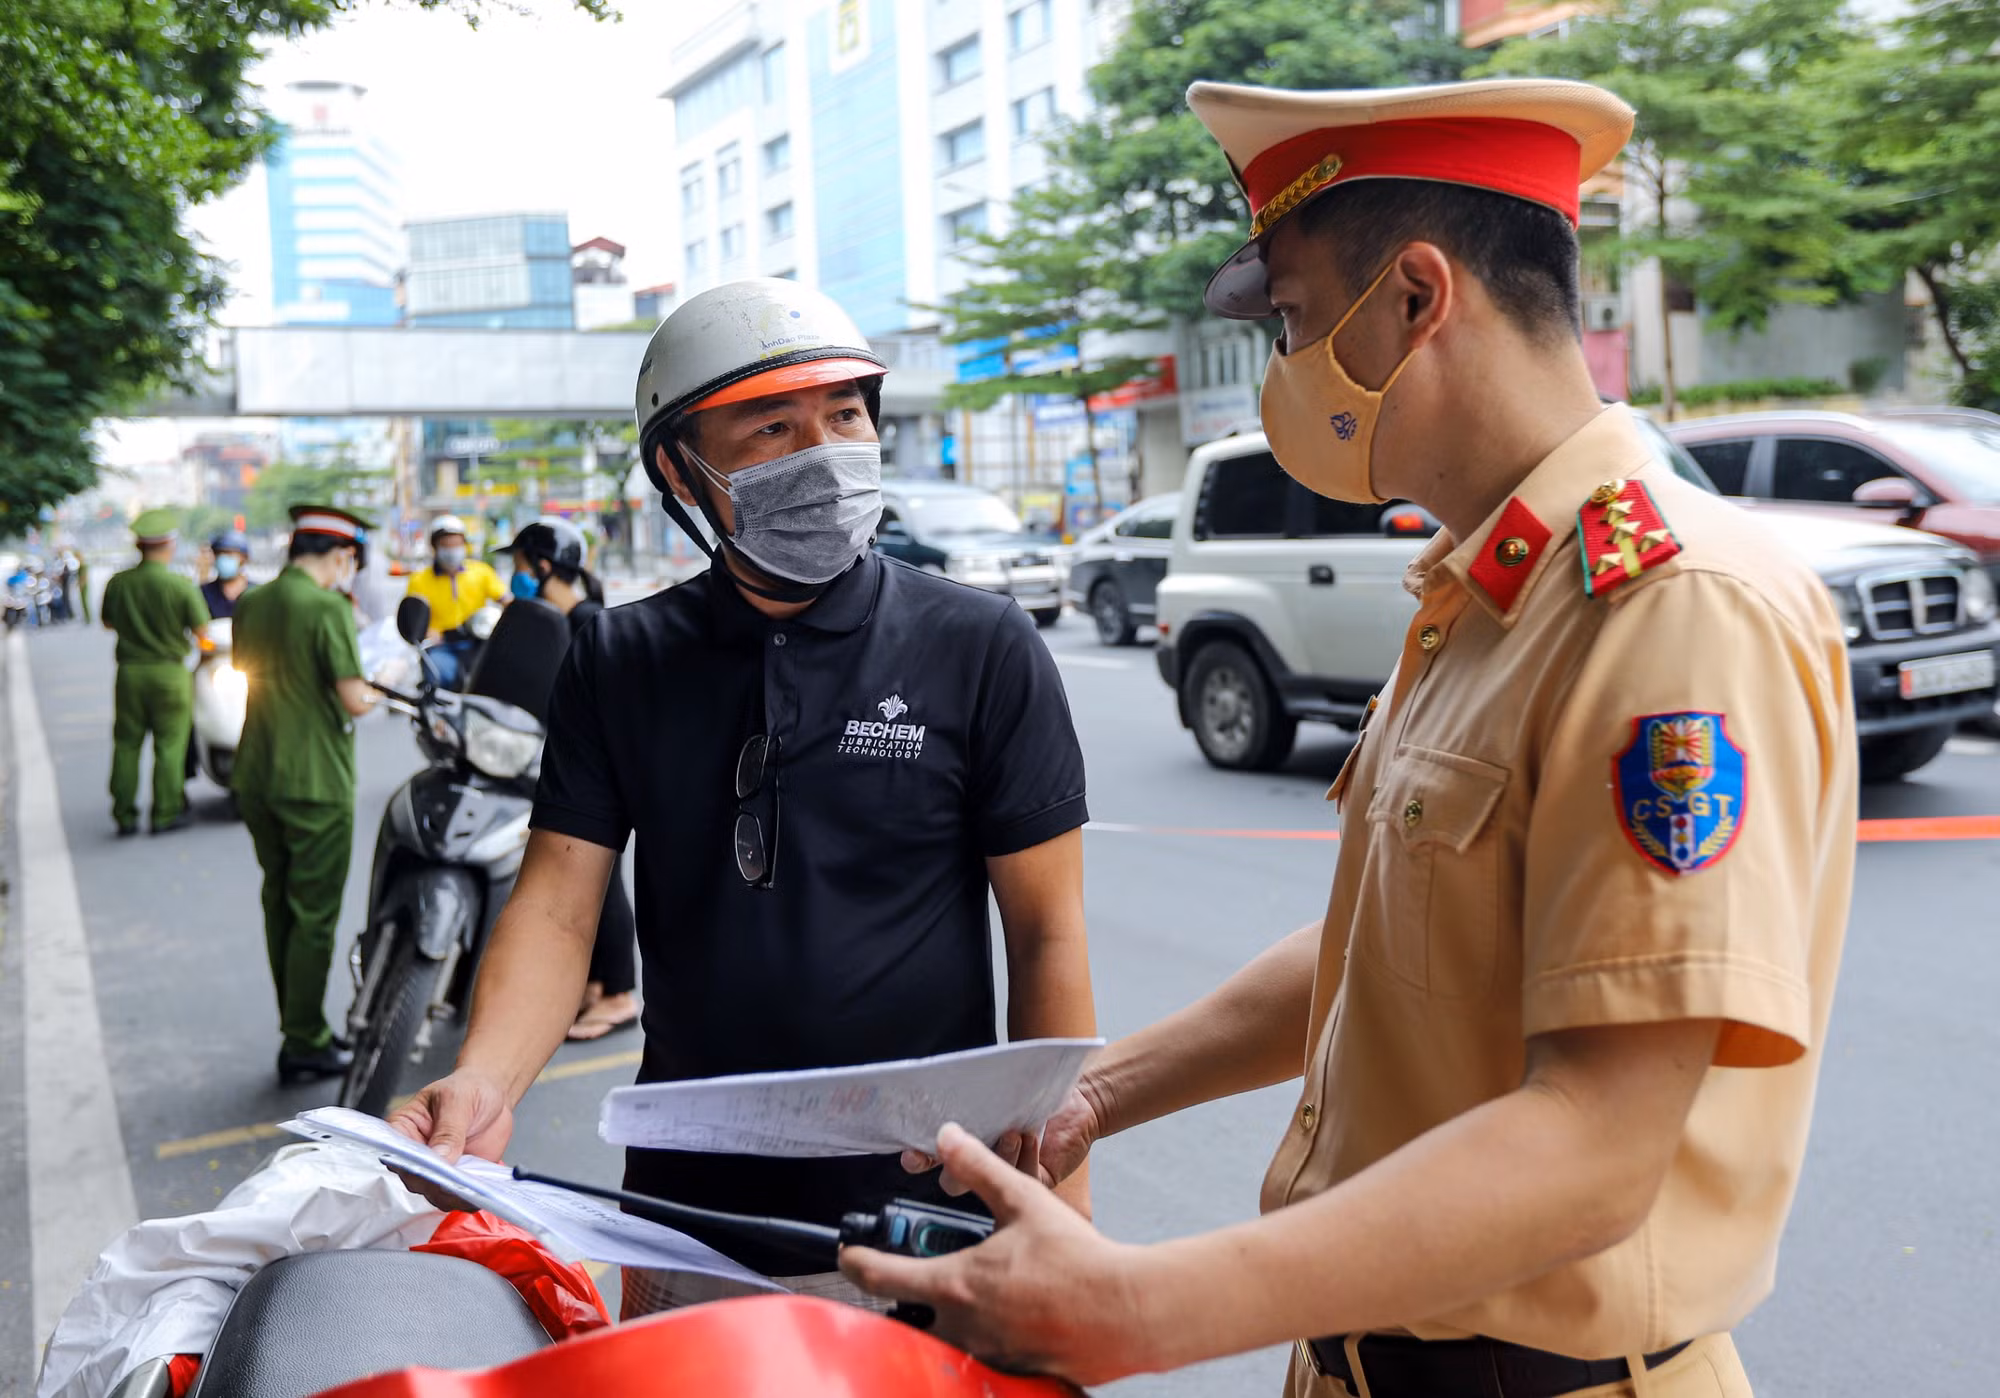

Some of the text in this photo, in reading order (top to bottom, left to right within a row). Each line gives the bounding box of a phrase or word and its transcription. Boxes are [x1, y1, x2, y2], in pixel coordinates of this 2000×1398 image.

[844, 720, 926, 742] BECHEM
[840, 736, 923, 751] LUBRICATION
[837, 745, 921, 760] TECHNOLOGY
